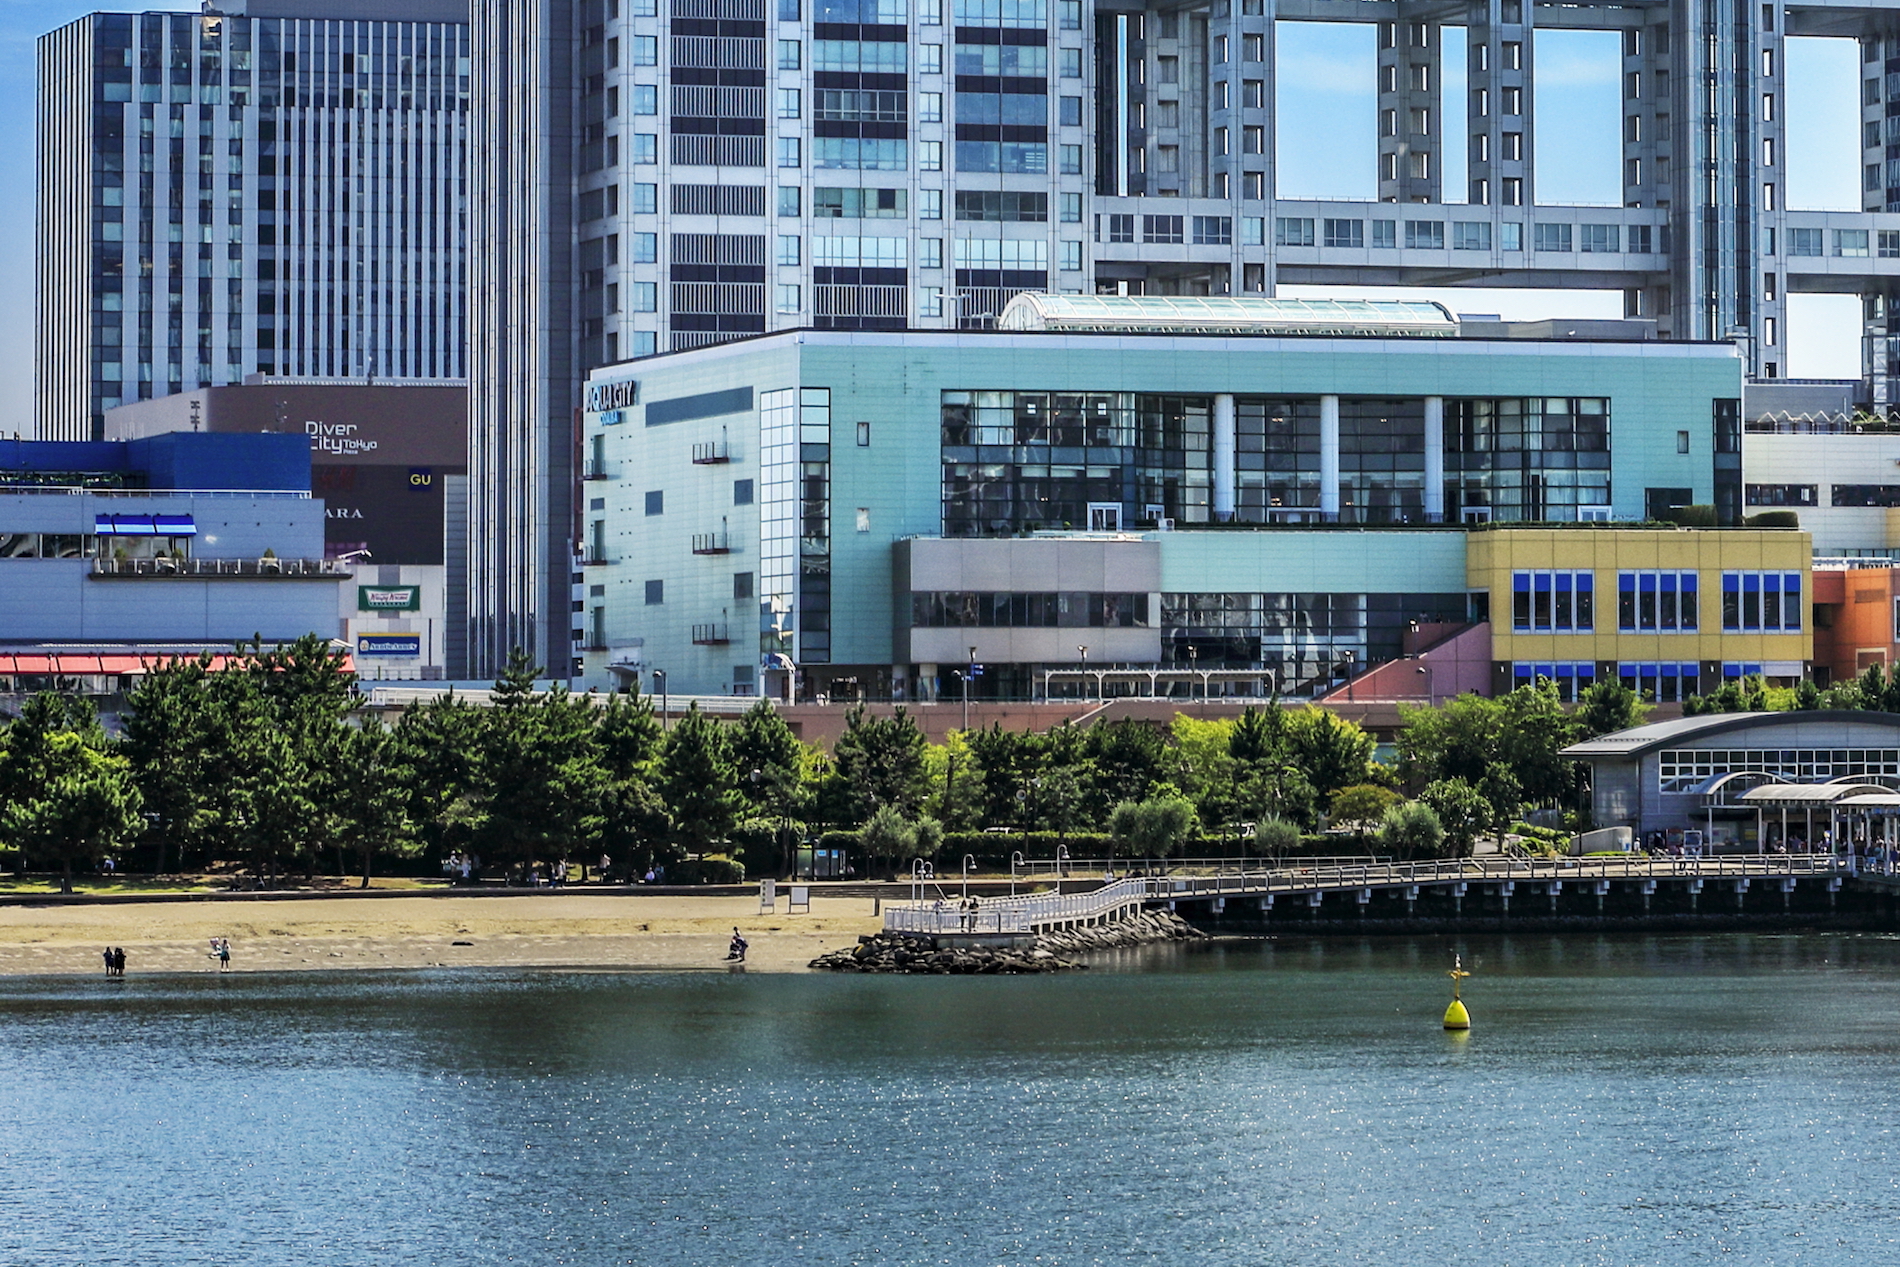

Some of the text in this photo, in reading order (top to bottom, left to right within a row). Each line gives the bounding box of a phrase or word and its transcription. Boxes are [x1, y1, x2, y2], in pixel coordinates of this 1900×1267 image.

[305, 421, 357, 435] Diver
[410, 474, 431, 485] GU
[325, 508, 364, 519] ARA
